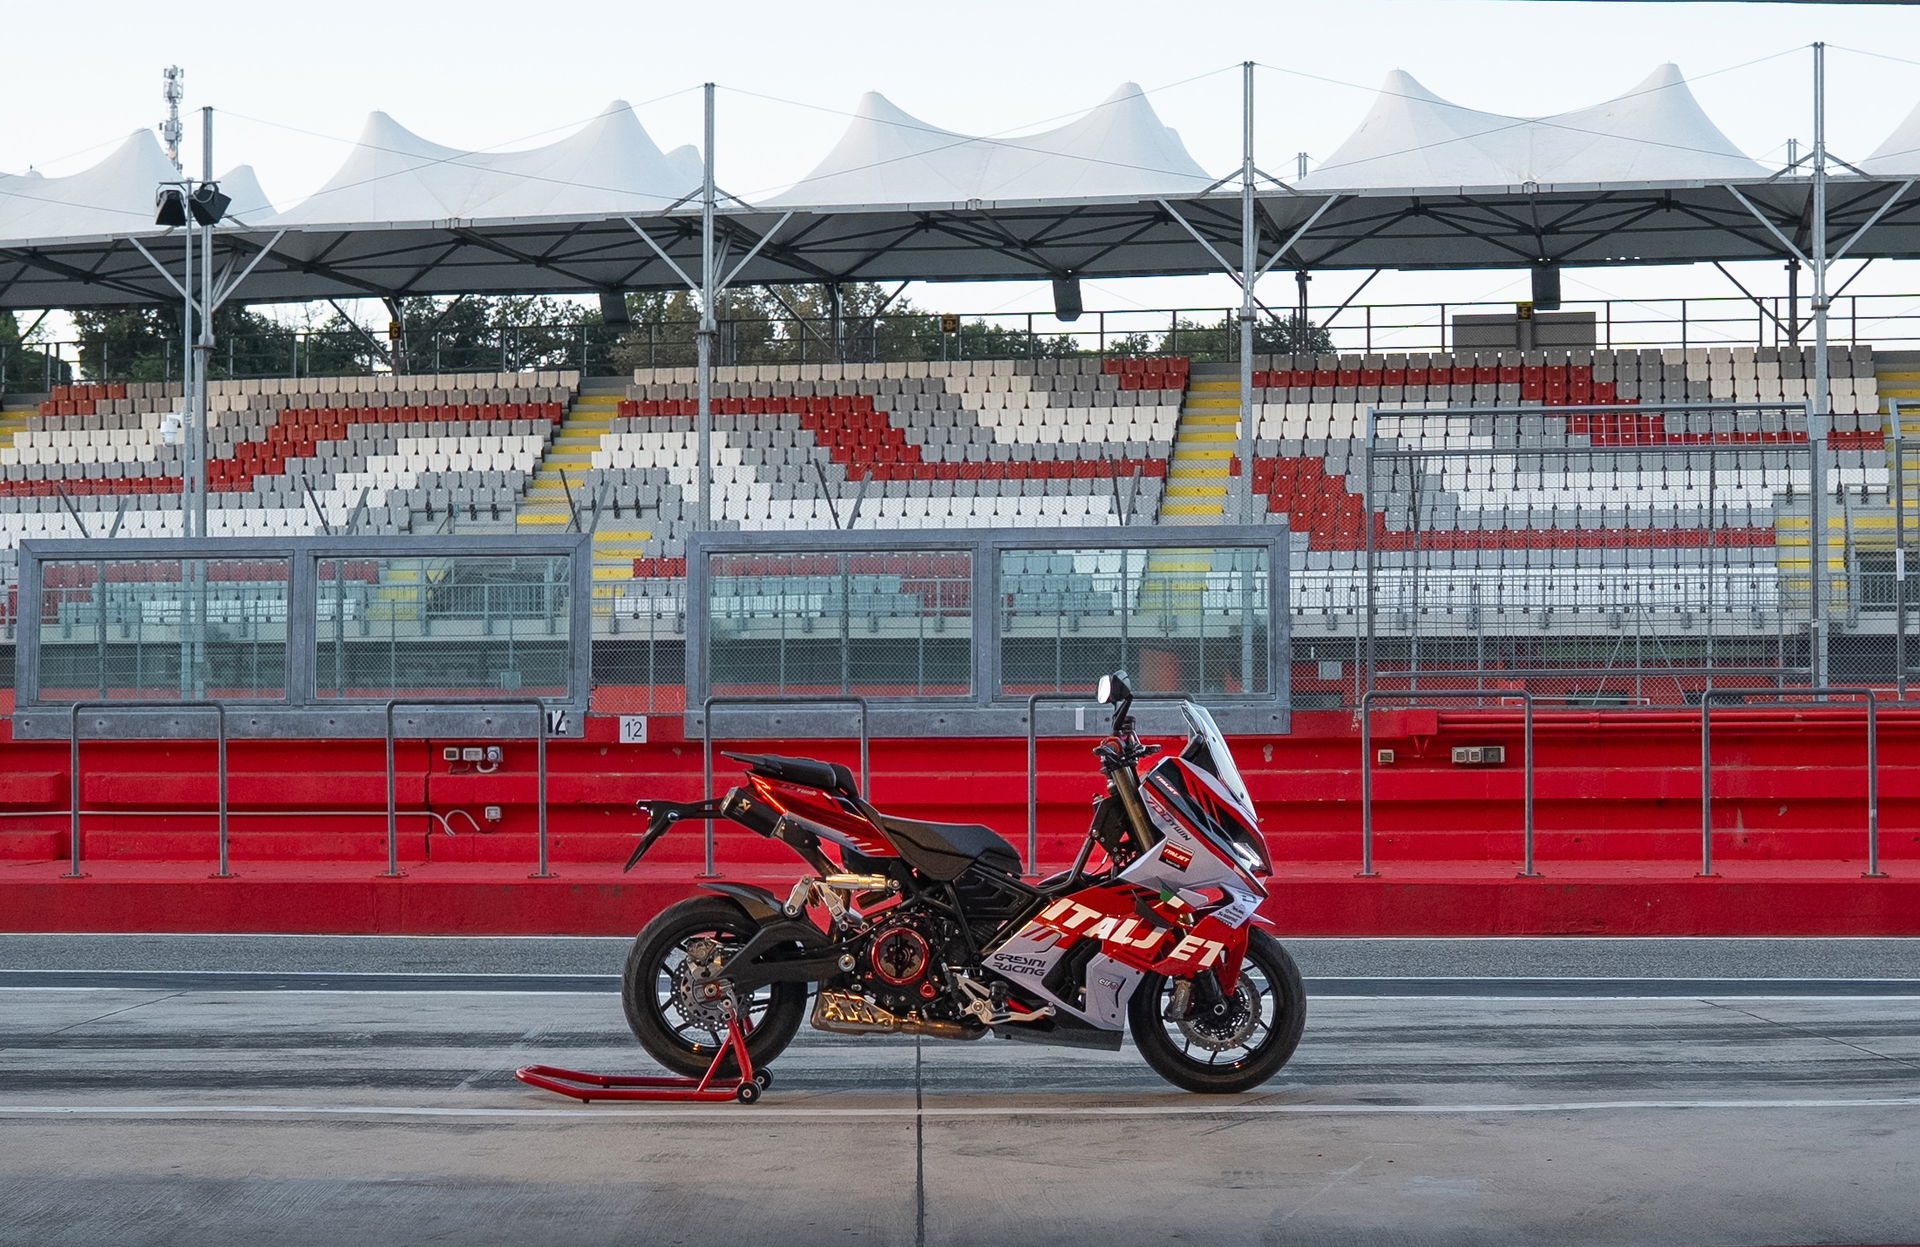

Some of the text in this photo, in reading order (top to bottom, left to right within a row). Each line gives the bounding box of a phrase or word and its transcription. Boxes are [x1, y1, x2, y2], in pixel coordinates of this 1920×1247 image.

[624, 721, 642, 738] 12
[1164, 848, 1190, 863] ITALJET
[994, 953, 1046, 968] GRESINI
[992, 961, 1046, 977] RACING
